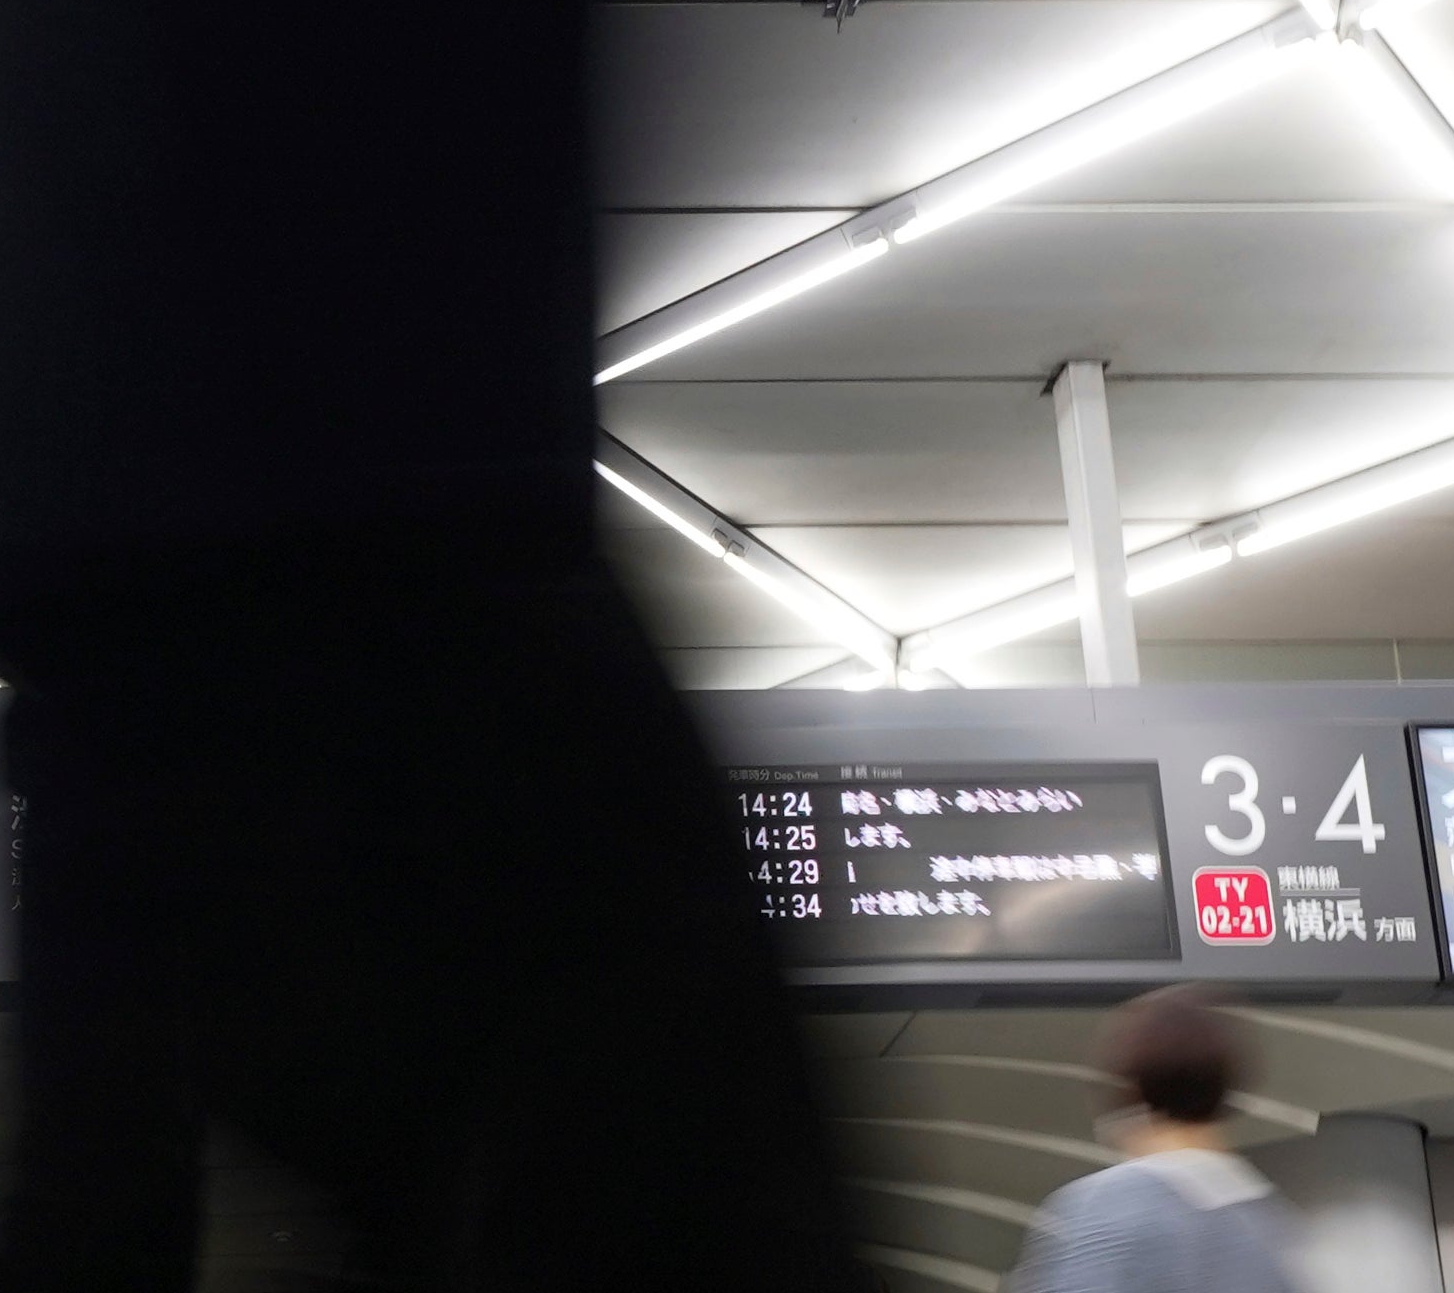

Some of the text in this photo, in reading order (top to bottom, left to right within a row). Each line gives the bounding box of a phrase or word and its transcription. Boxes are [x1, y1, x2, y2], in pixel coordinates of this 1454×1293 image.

[738, 791, 813, 817] 14:24
[1214, 877, 1249, 903] TY
[1283, 899, 1417, 943] 横浜 方面
